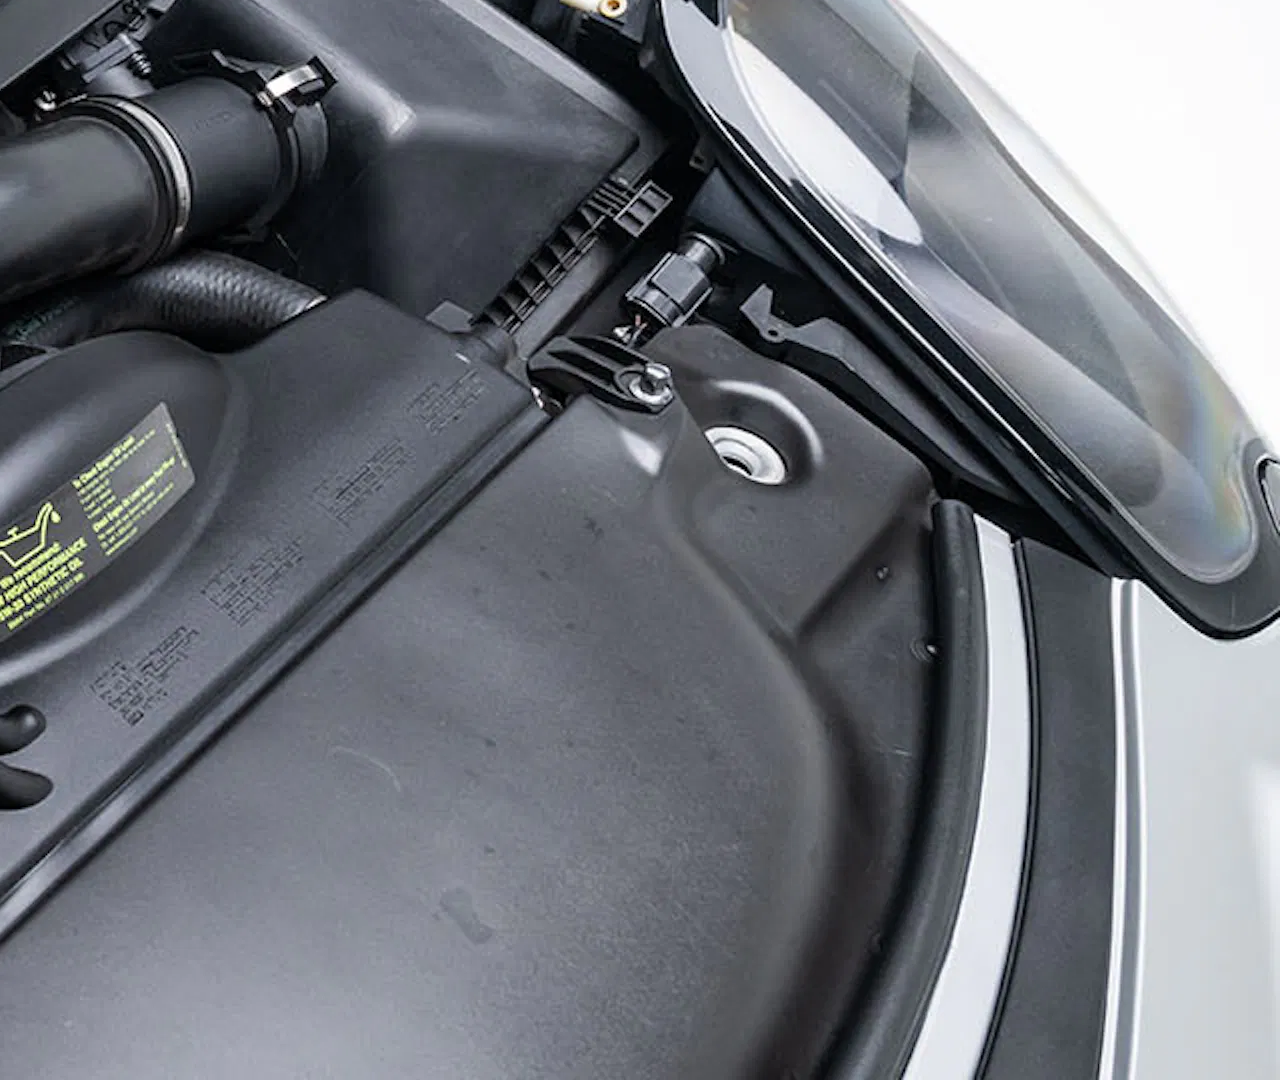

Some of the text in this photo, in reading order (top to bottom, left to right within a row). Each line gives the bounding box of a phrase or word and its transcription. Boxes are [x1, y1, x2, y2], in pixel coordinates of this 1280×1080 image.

[3, 579, 29, 601] HIGH
[25, 536, 88, 587] PERFORMANCE
[22, 565, 70, 605] SYNTHETIC
